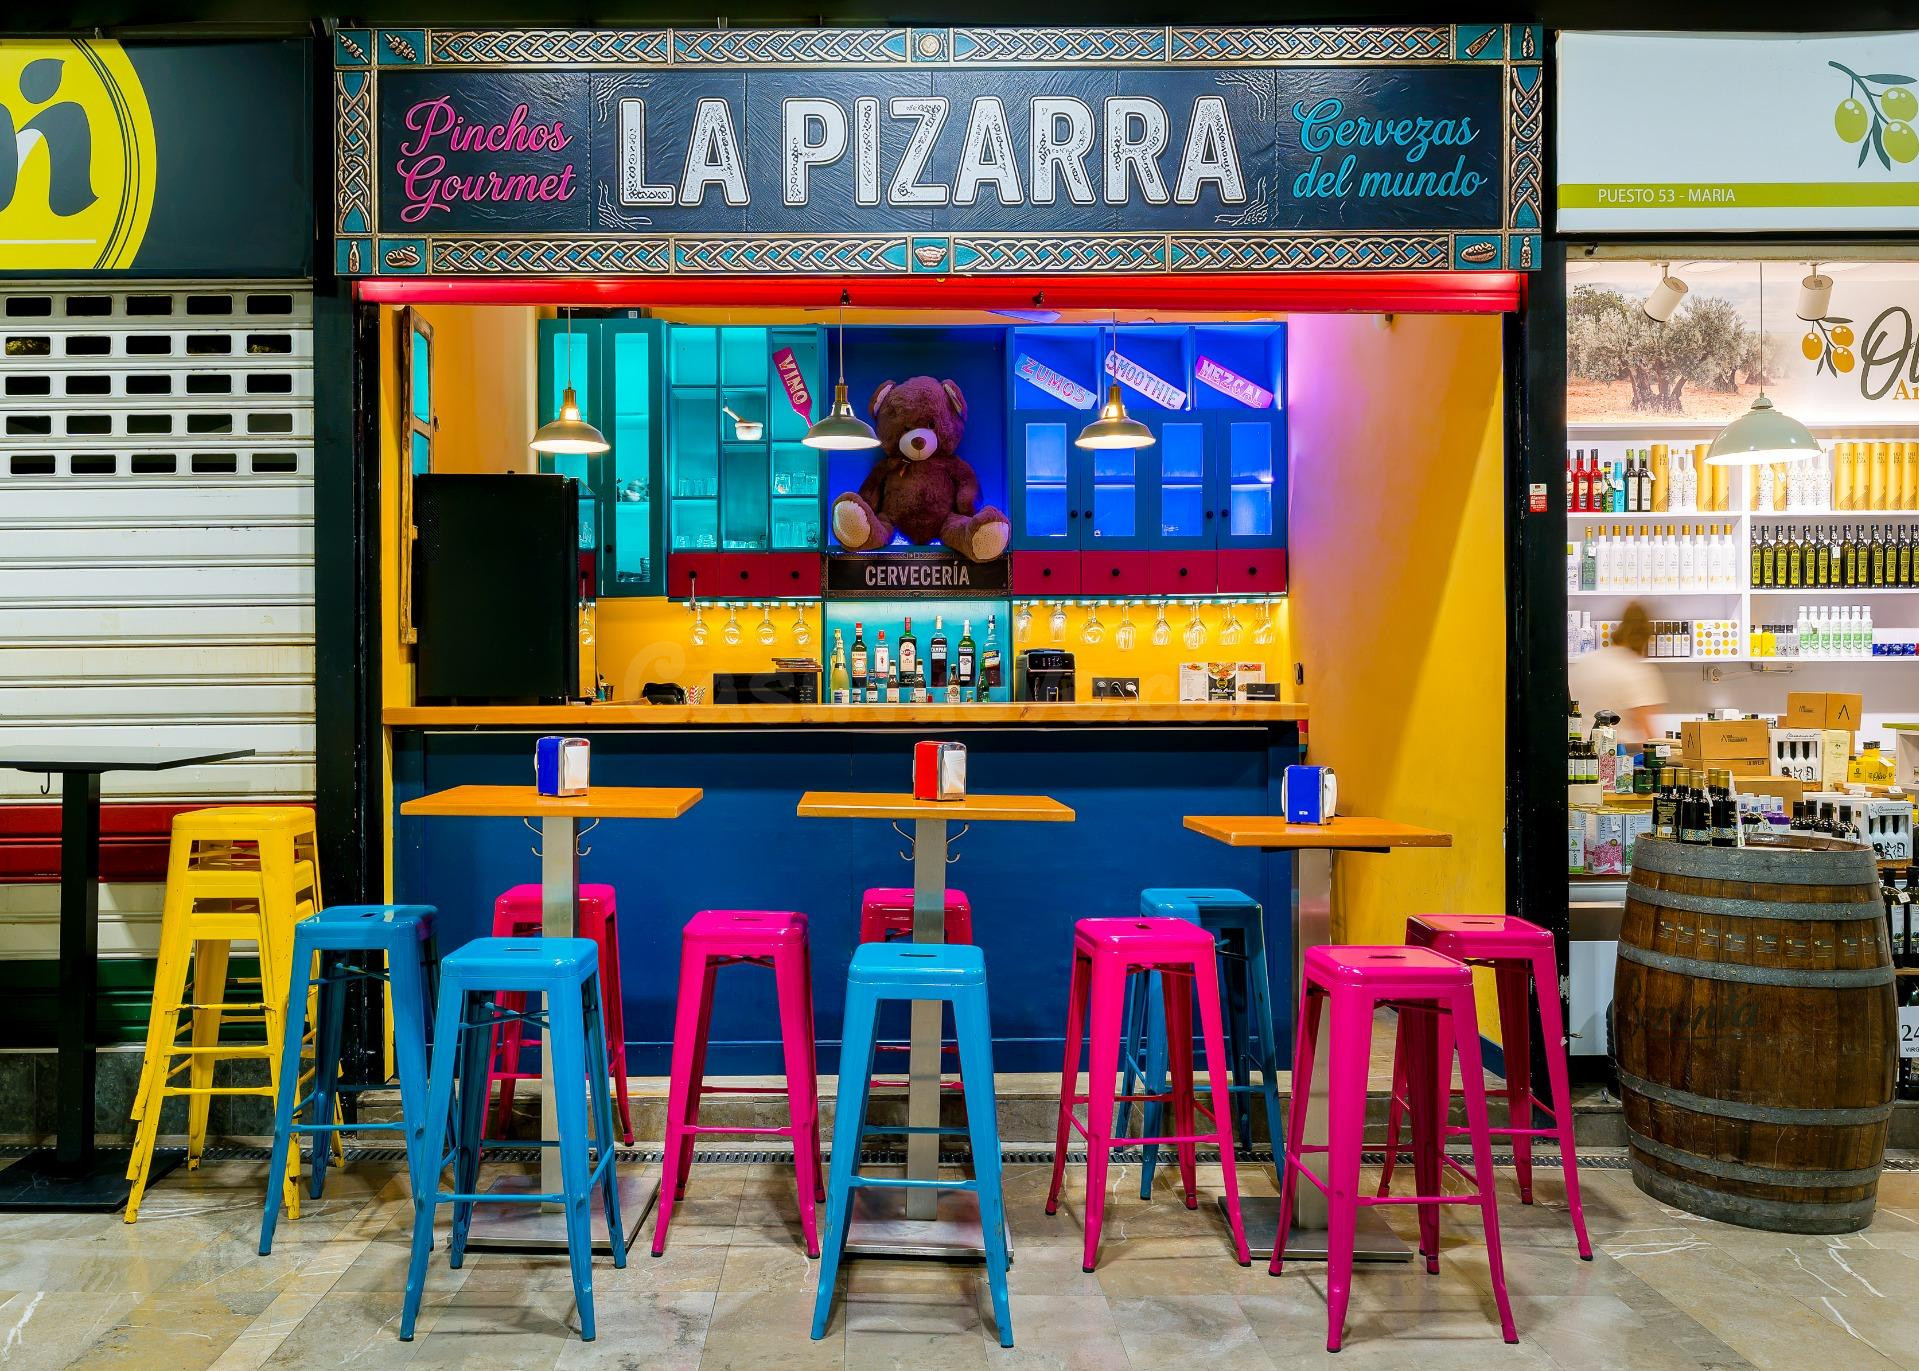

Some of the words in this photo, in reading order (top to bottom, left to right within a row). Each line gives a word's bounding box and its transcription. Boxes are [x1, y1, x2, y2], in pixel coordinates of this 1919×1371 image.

[397, 94, 573, 157] Pinchos
[619, 96, 751, 206] LA
[782, 95, 1247, 206] PIZARRA
[1292, 97, 1480, 163] Cervezas
[396, 156, 577, 223] Gourmet
[1292, 153, 1355, 200] del
[1359, 157, 1488, 199] mundo
[1597, 188, 1655, 203] PUESTO
[1658, 188, 1676, 203] 53
[1687, 187, 1736, 202] MARIA
[778, 352, 808, 406] VINO
[1020, 356, 1088, 405] ZUMOS
[1105, 353, 1181, 409] SMOOTHIE
[1199, 359, 1264, 409] MEZCAL
[865, 561, 971, 586] CERVECERÍA
